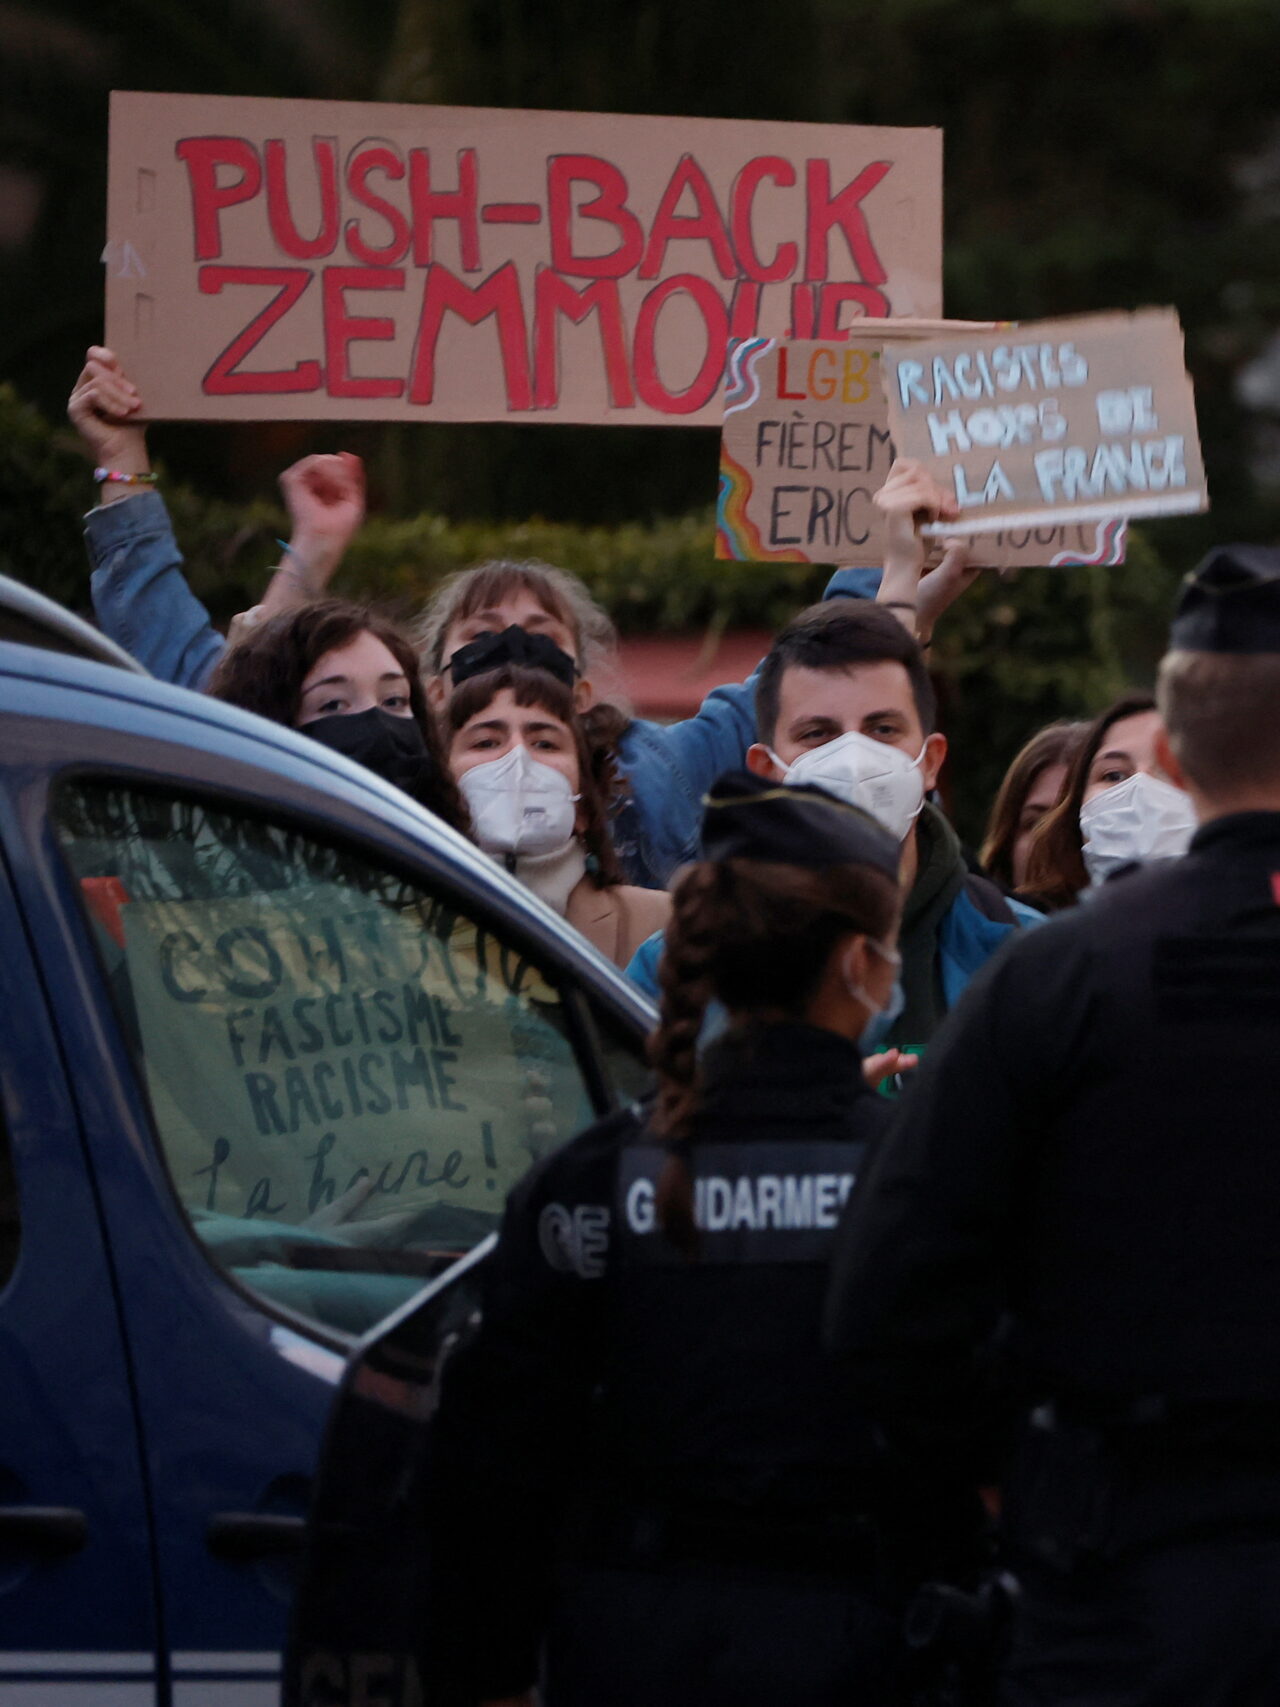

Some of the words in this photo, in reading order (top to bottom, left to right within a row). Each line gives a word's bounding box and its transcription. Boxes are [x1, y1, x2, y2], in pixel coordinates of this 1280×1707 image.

[175, 135, 894, 284] PUSH-BACK
[776, 346, 881, 403] LGB
[769, 485, 871, 546] ERIC
[952, 459, 1016, 507] LA
[226, 983, 464, 1067] FASCISME
[244, 1046, 467, 1136] RACISME
